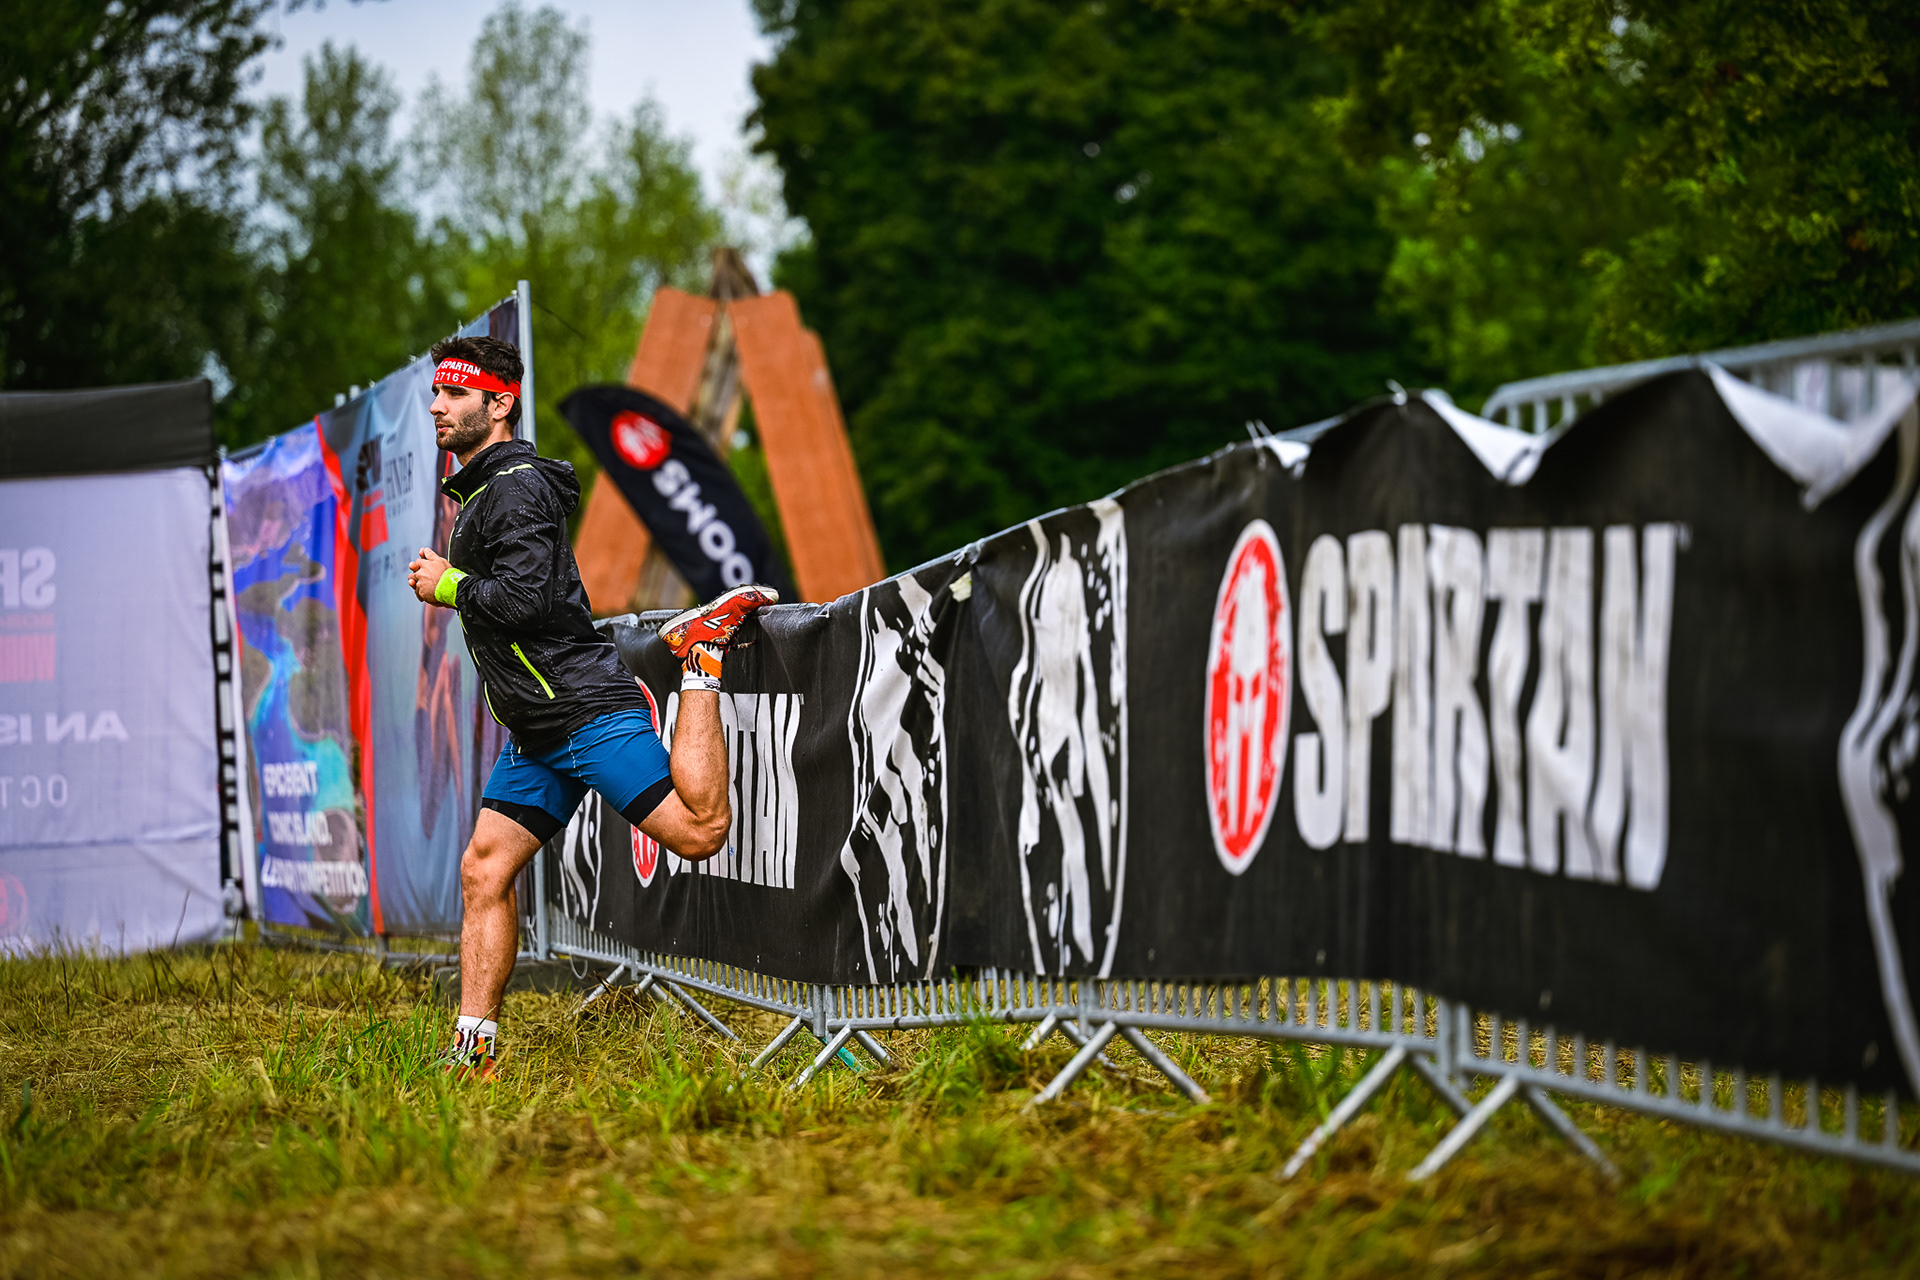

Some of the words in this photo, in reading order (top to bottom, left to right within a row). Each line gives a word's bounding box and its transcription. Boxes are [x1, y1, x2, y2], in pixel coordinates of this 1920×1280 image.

[441, 360, 481, 376] SPARTAN
[435, 371, 468, 383] 27167
[1294, 522, 1676, 891] SPARTAN
